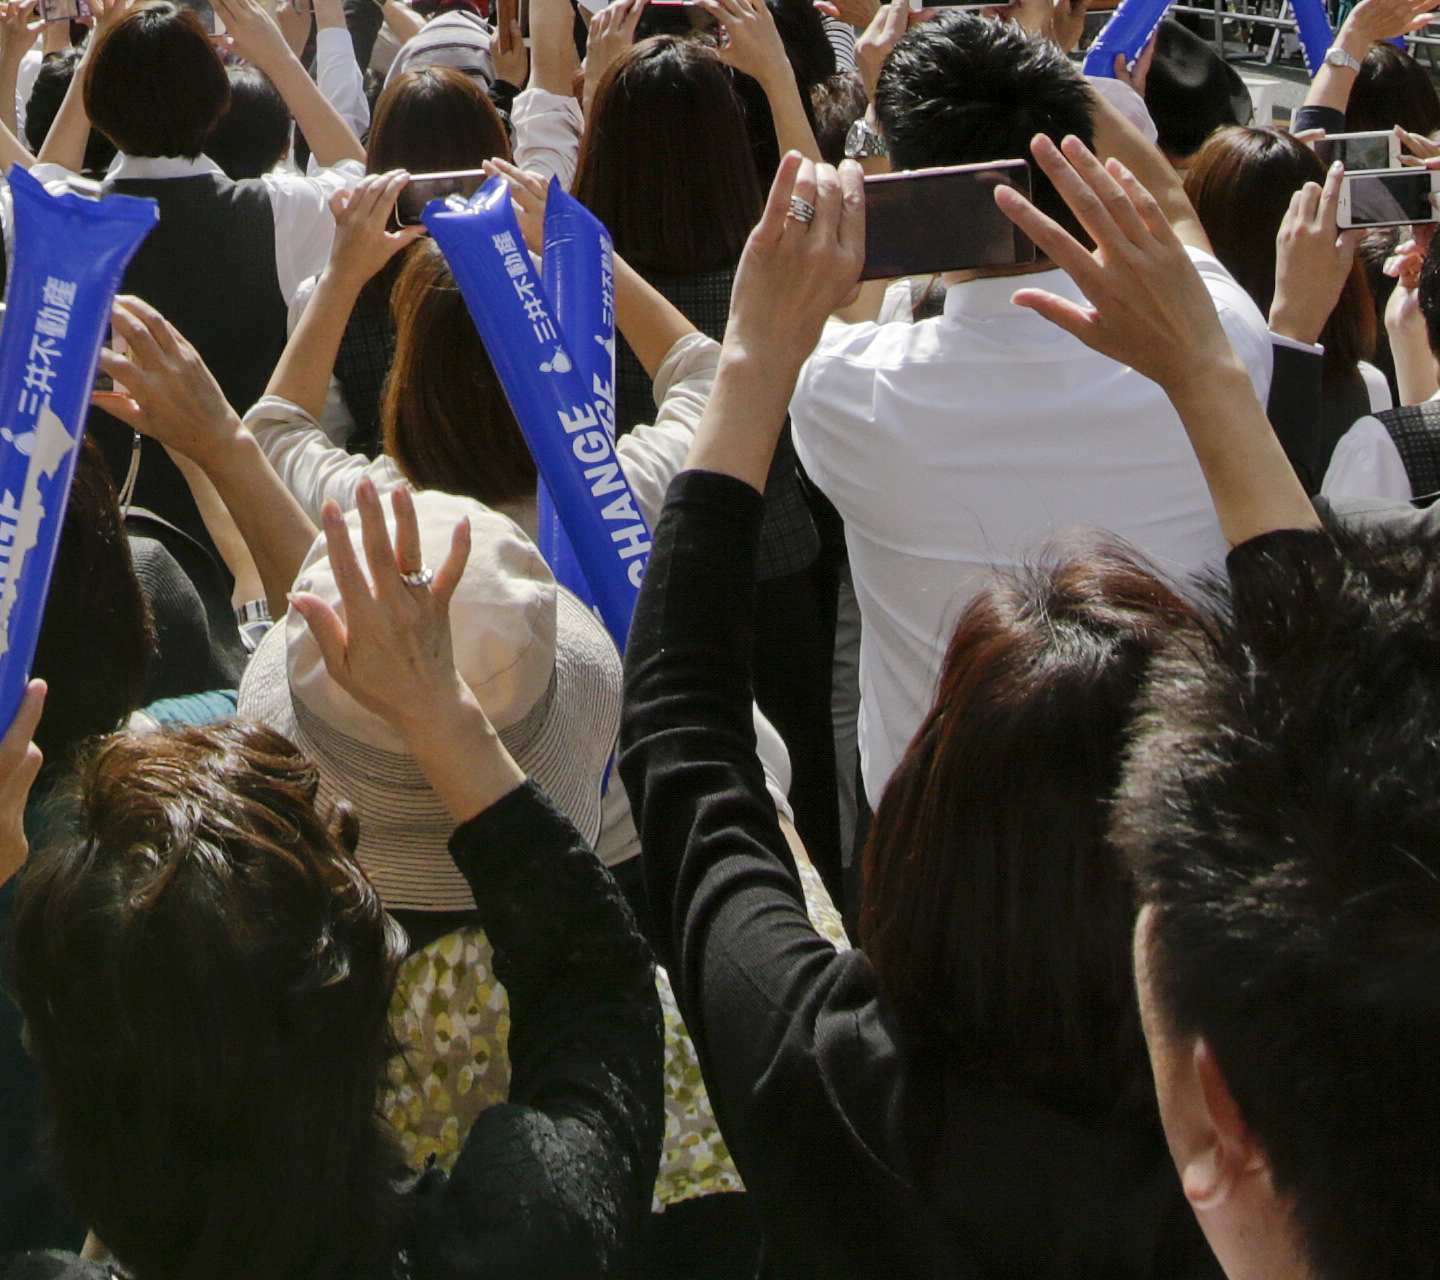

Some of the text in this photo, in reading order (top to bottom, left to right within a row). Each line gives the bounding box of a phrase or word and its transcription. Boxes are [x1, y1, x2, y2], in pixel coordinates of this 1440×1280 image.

[23, 275, 79, 417] 三井不動産
[493, 230, 558, 346] 三井不動産
